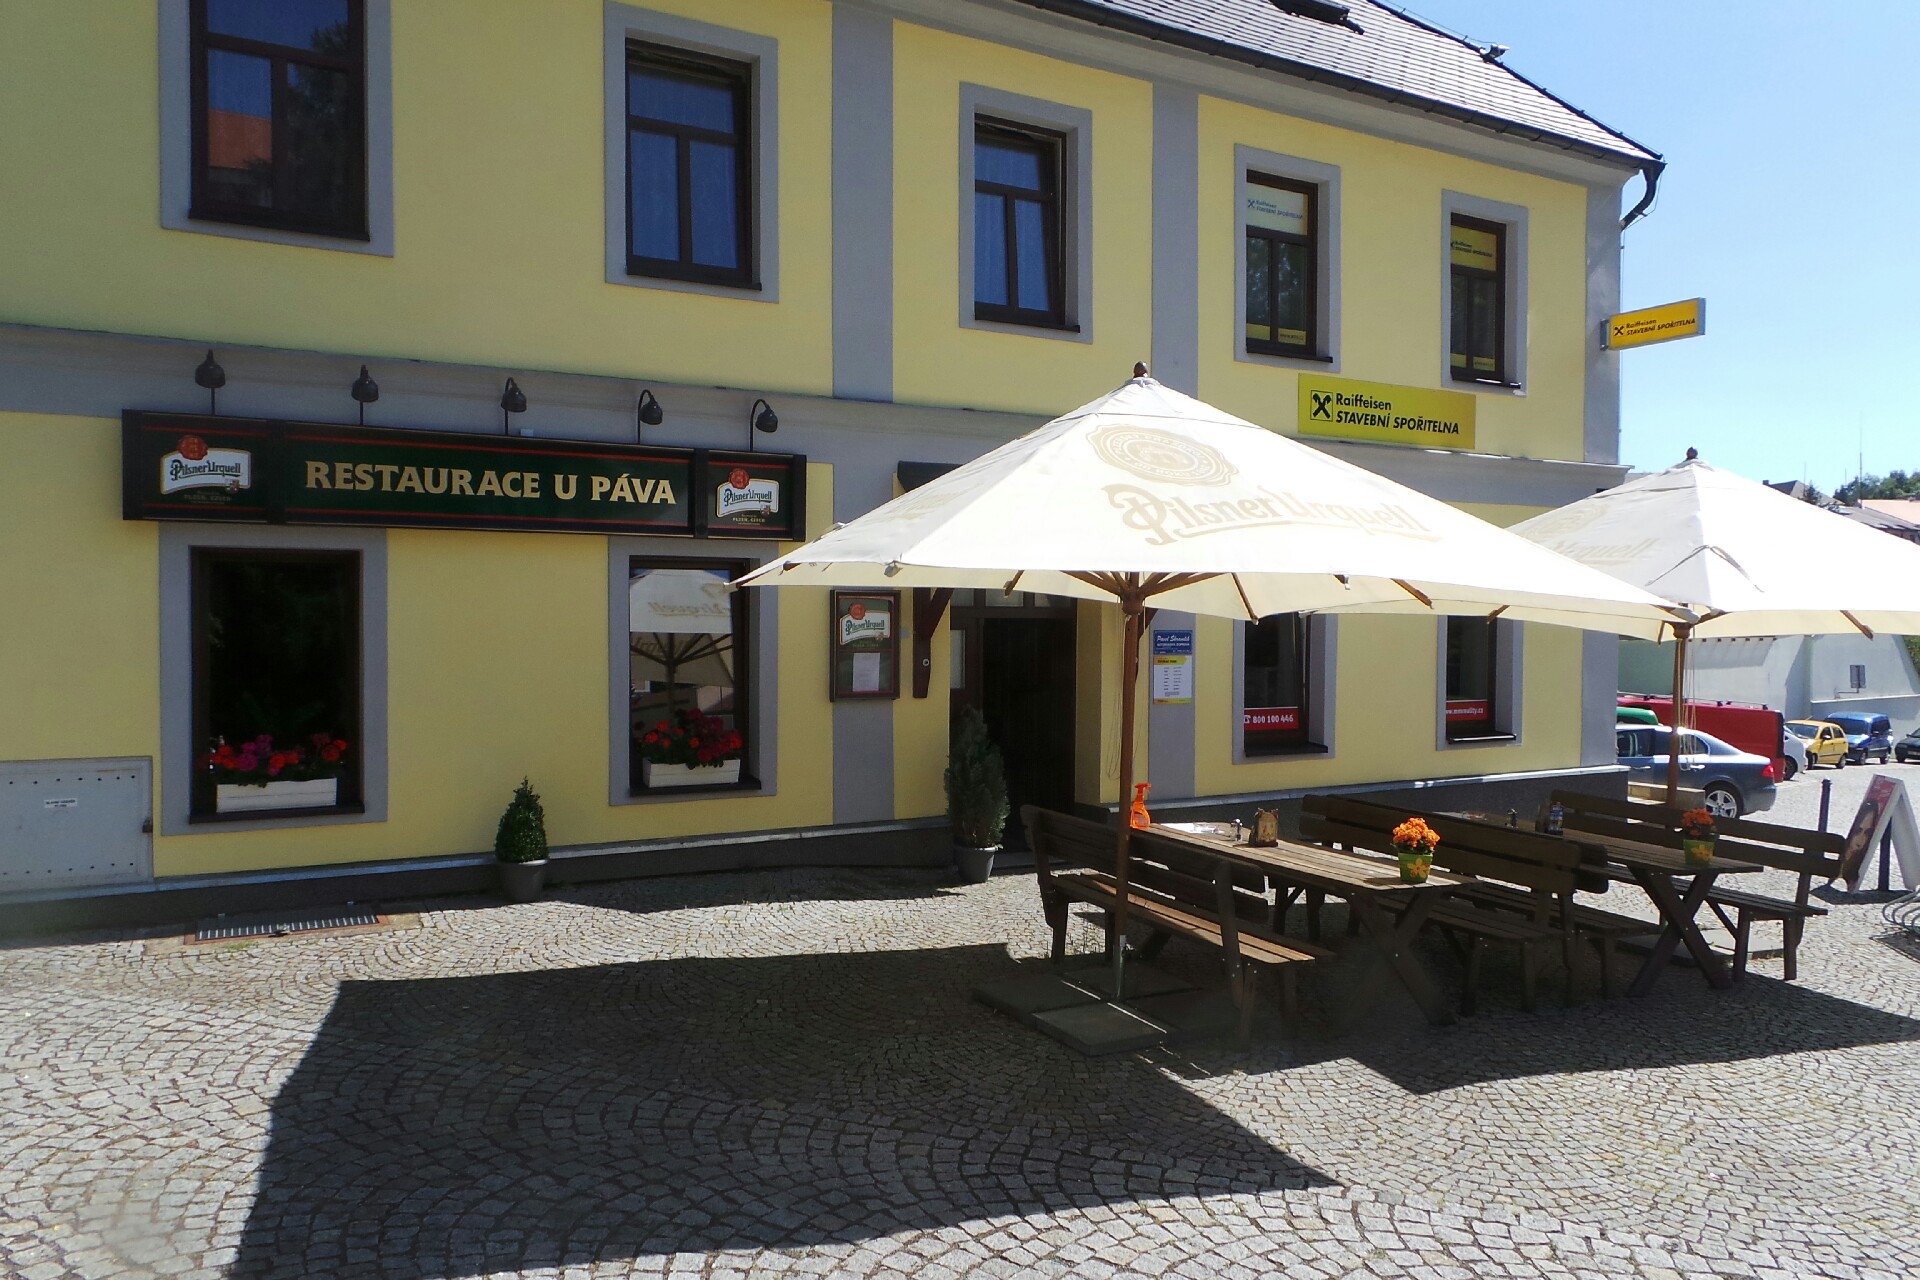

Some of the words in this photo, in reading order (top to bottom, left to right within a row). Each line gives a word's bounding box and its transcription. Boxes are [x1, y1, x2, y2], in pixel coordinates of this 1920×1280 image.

[1336, 392, 1392, 411] Raiffeisen
[1336, 410, 1390, 428] STAVEBNÍ
[1392, 415, 1460, 435] SPOŘITELNA
[170, 459, 207, 481] Pilsner
[207, 460, 241, 477] Urquell
[305, 460, 541, 499] RESTAURACE
[554, 474, 578, 500] U
[590, 473, 677, 505] PÁVA
[724, 488, 749, 507] Pilsner
[748, 489, 772, 503] Urquell
[1100, 483, 1283, 546] Pilsner
[1257, 484, 1431, 535] Urquell
[845, 620, 865, 635] Pilsner
[865, 620, 885, 631] Urquell
[1252, 715, 1266, 724] 800
[1267, 714, 1280, 723] 100
